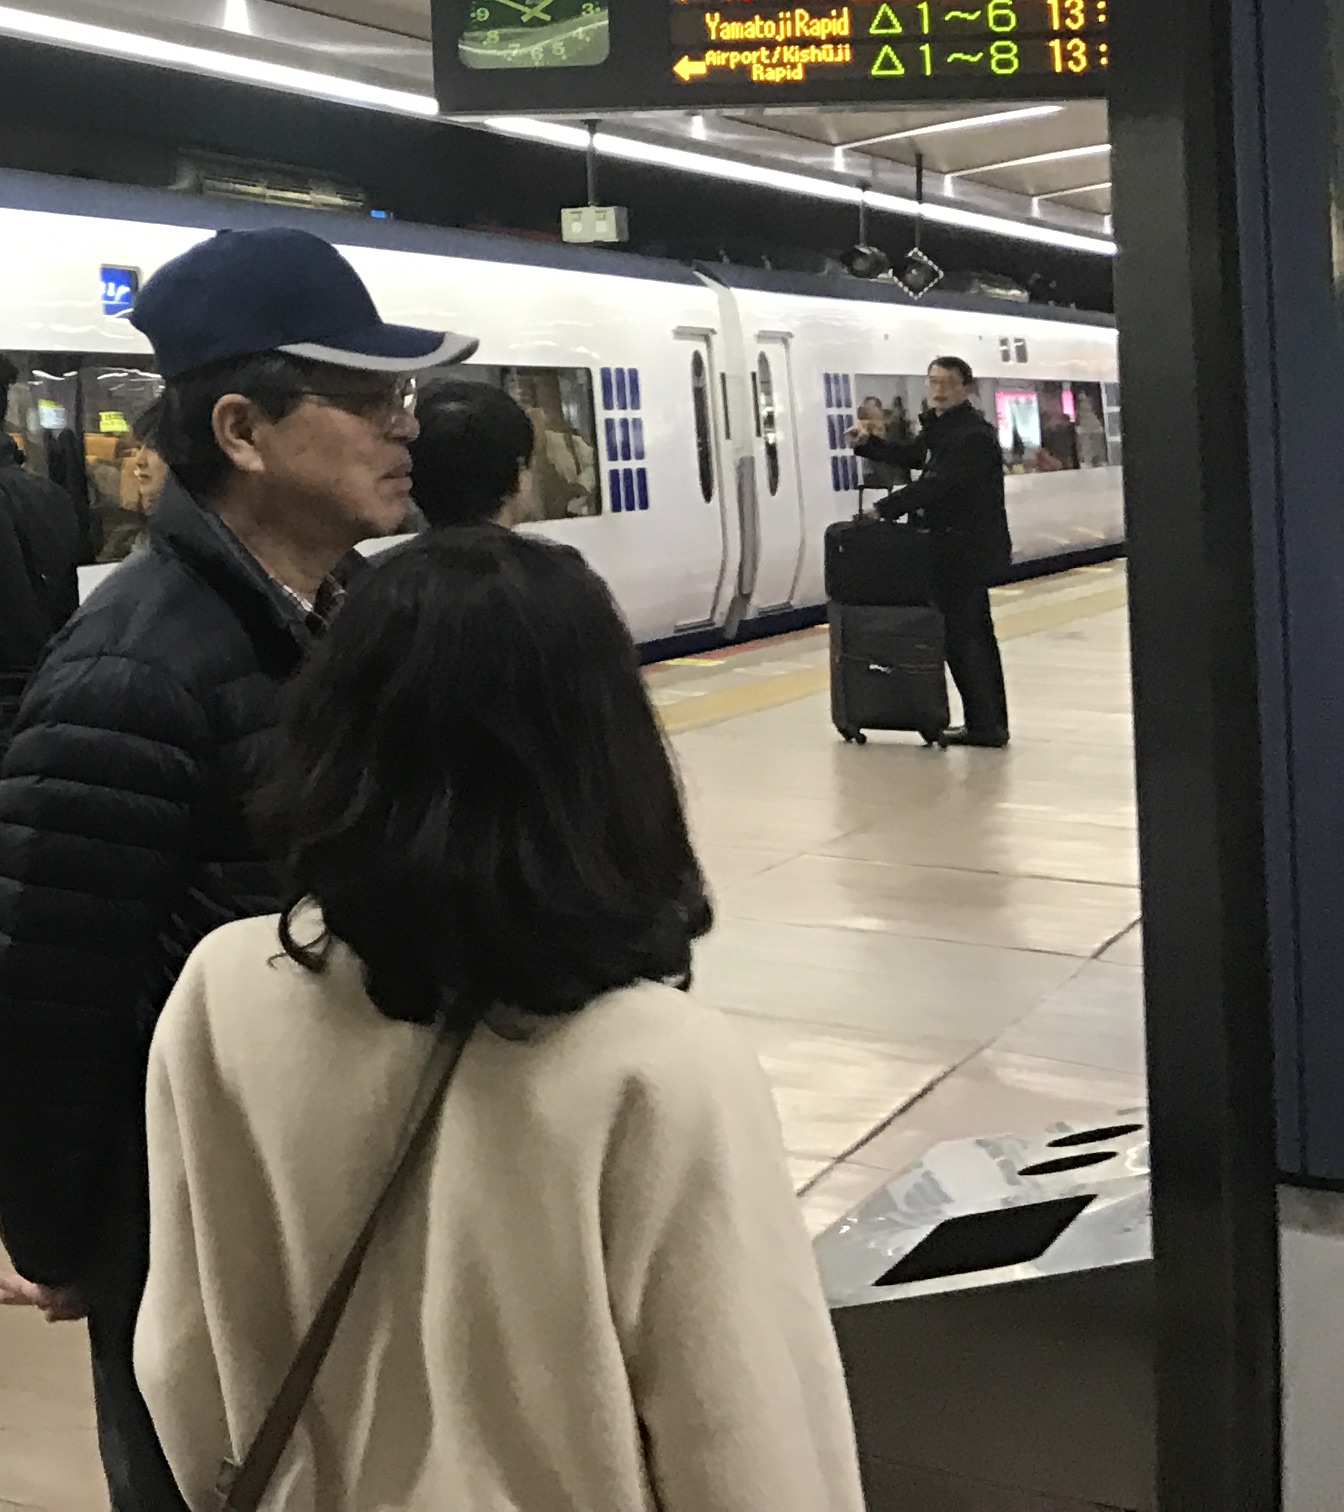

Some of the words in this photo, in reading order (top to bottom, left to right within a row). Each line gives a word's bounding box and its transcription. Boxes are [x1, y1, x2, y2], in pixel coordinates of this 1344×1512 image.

[476, 7, 490, 21] 9
[581, 2, 595, 16] 3
[705, 10, 792, 42] Yamatoji
[794, 6, 850, 40] Rapid
[486, 29, 500, 45] 8
[530, 46, 544, 60] 6
[551, 42, 566, 56] 5
[751, 62, 803, 82] Rapid
